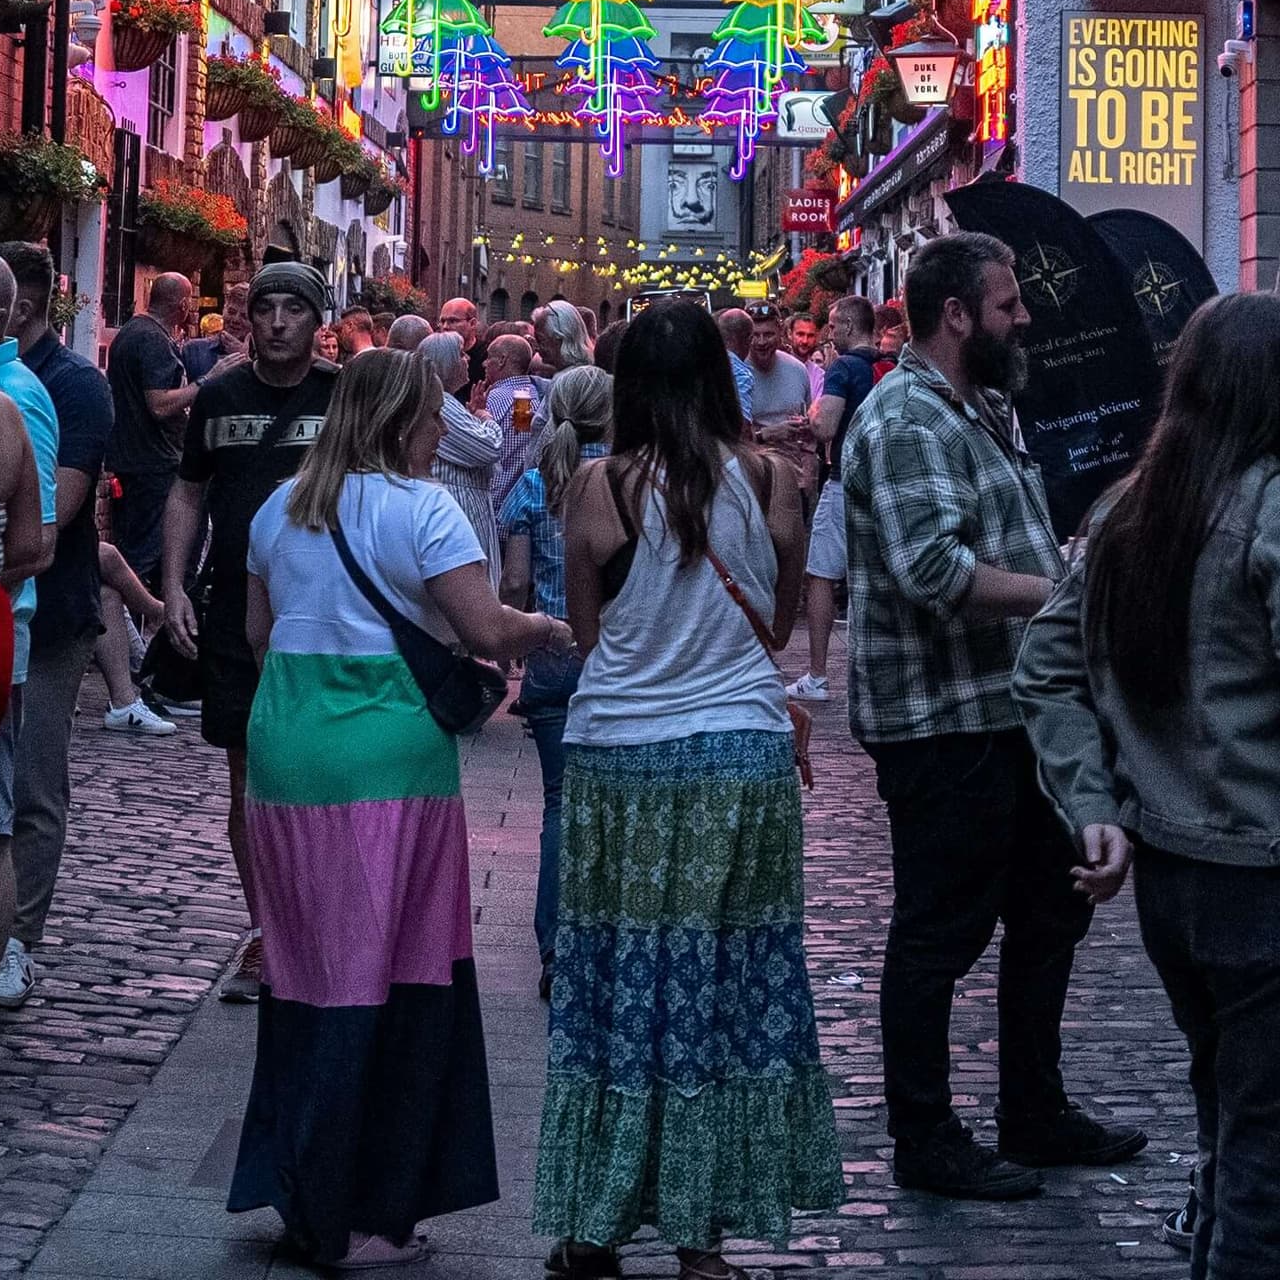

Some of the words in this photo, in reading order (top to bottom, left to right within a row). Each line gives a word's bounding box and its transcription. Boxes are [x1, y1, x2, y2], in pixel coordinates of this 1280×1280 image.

[1068, 18, 1199, 48] EVERYTHING
[914, 63, 937, 72] DUKE
[920, 74, 931, 83] OF
[1068, 49, 1098, 86] IS
[1104, 50, 1199, 89] GOING
[914, 84, 939, 94] YORK
[1068, 89, 1128, 149] TO
[1139, 91, 1198, 151] BE
[1068, 150, 1114, 183] ALL
[1120, 151, 1198, 186] RIGHT
[789, 198, 831, 208] LADIES
[791, 212, 828, 222] ROOM
[1027, 338, 1054, 357] ritical
[1080, 325, 1118, 341] Reviews
[1035, 409, 1097, 433] Navigating
[1099, 397, 1142, 419] Science
[1067, 446, 1089, 460] June
